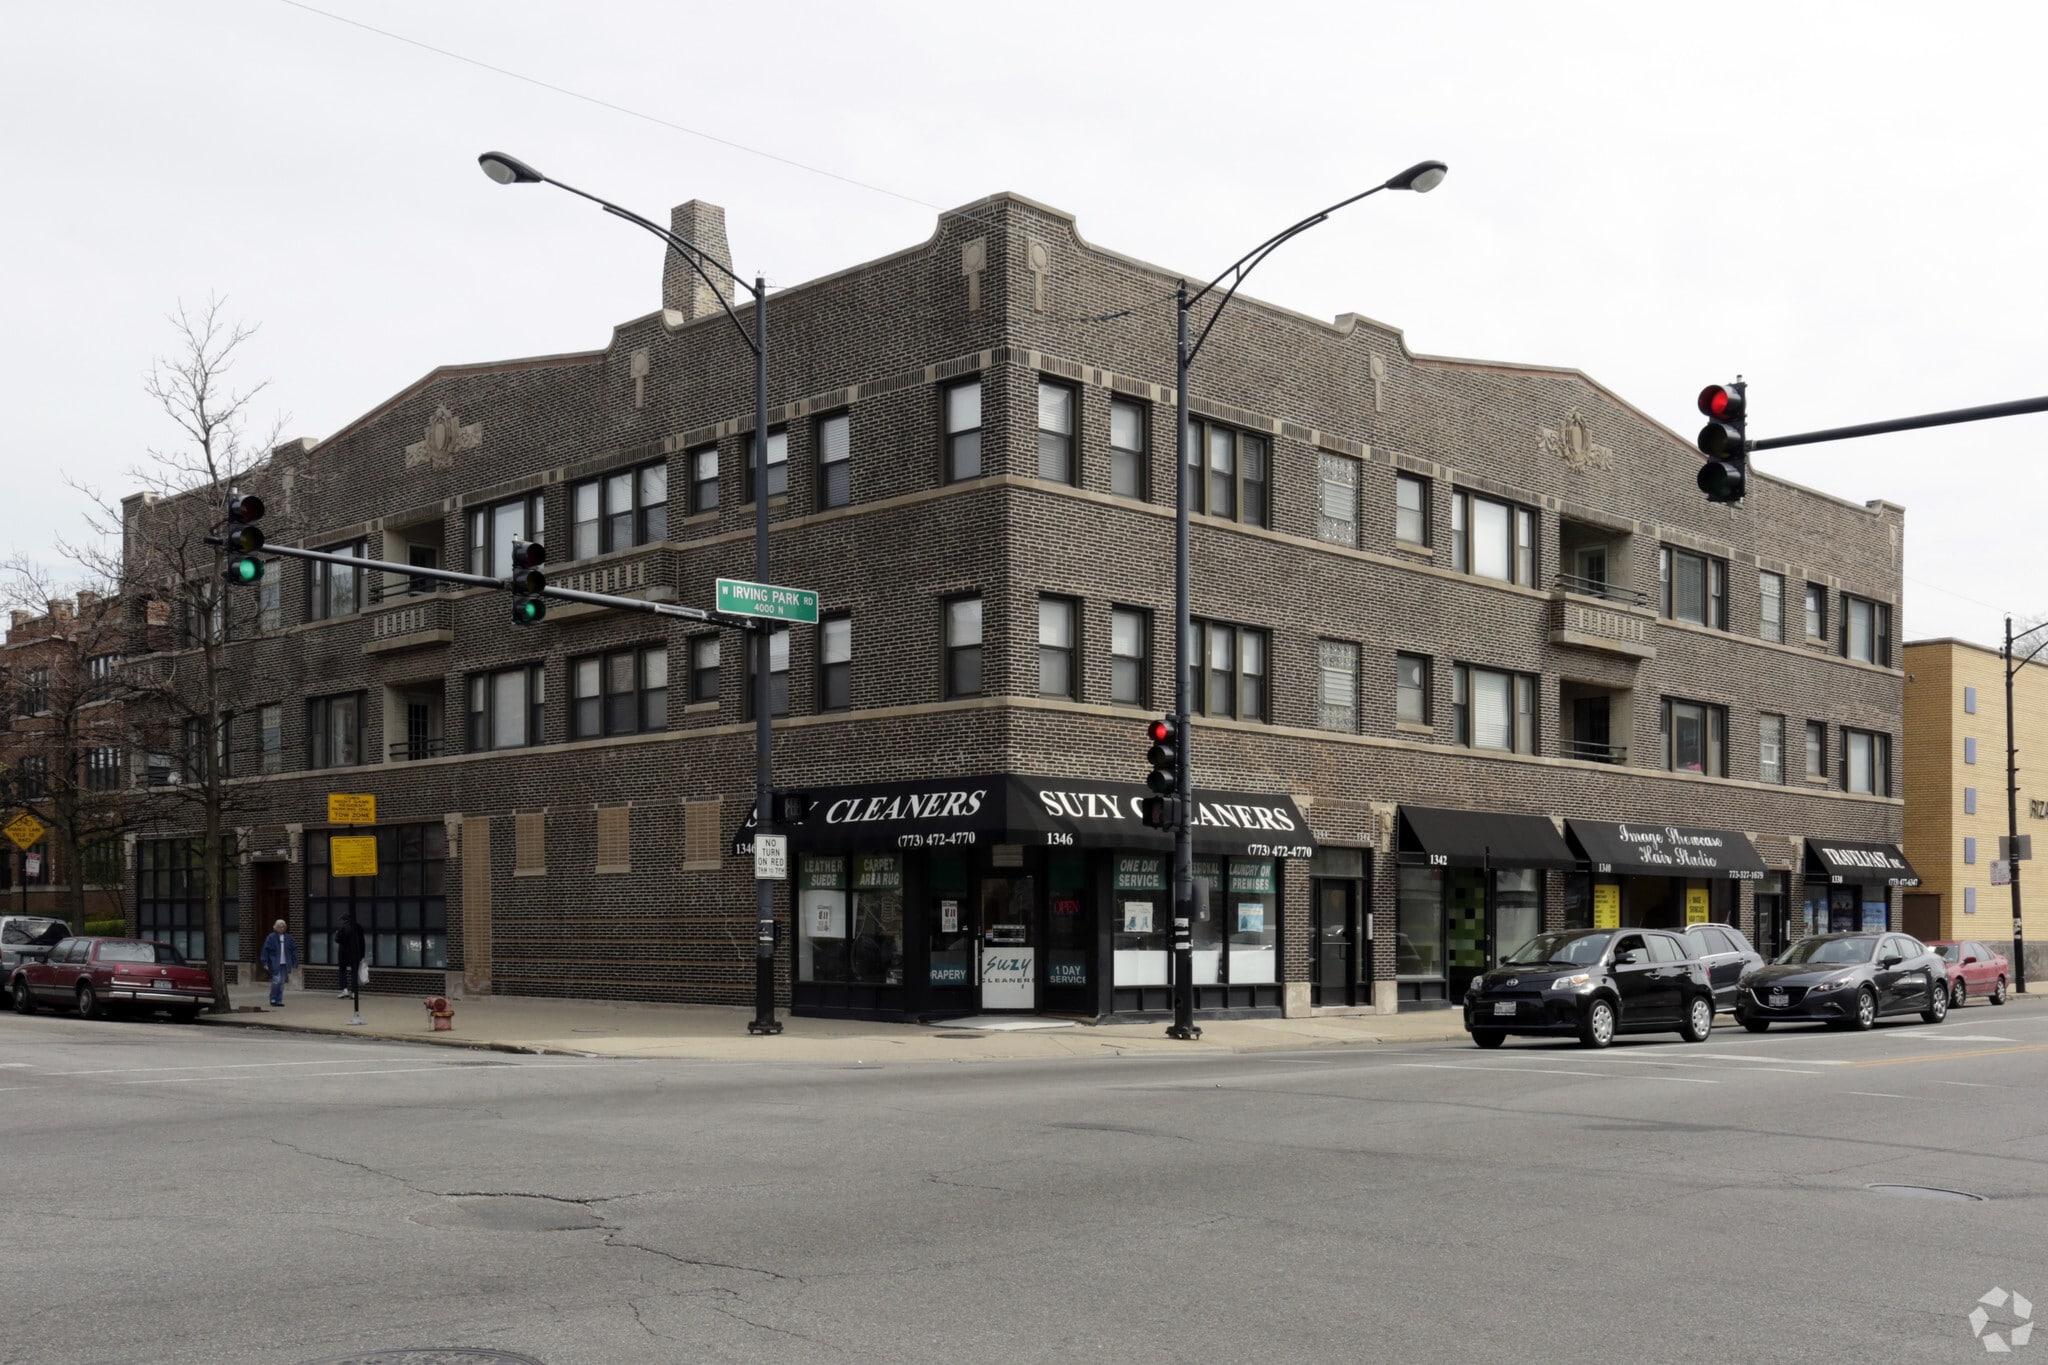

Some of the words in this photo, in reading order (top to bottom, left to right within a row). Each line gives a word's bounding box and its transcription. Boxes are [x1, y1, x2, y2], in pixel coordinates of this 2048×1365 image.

[722, 586, 729, 595] W
[733, 585, 768, 602] IRVING
[772, 591, 800, 606] PARK
[803, 597, 814, 606] RD
[754, 603, 774, 613] 4000
[778, 606, 784, 615] N
[826, 790, 987, 824] CLEANERS
[1039, 790, 1126, 820] SUZY
[1130, 796, 1295, 831] CANERS
[765, 839, 776, 847] NO
[897, 835, 924, 847] (773)
[926, 832, 976, 846] 472-4770
[1046, 833, 1073, 846] 1346
[1619, 824, 1663, 850] Image
[1665, 826, 1723, 847] Showcase
[762, 848, 780, 856] TURN
[1248, 844, 1270, 856] (773)
[1272, 846, 1312, 858] 472-4770
[1638, 845, 1672, 865] Hair
[1674, 847, 1717, 867] Studio
[758, 857, 767, 866] ON
[771, 857, 784, 866] RED
[1430, 854, 1448, 866] 1342
[1822, 848, 1891, 868] TRAVELFAST
[805, 860, 843, 872] LEATHER
[864, 859, 895, 871] CARPET
[1120, 860, 1140, 871] ONE
[1141, 860, 1159, 872] DAY
[1229, 863, 1258, 875] LAUNDRY
[1260, 865, 1271, 877] ON
[811, 874, 838, 886] SUEDE
[860, 873, 880, 886] AREA
[883, 873, 900, 886] RUG
[1119, 874, 1159, 887] SERVICE
[1729, 870, 1764, 879] 773-327-1679
[1232, 878, 1270, 890] PREMISES
[1054, 900, 1080, 914] OPEN
[930, 969, 966, 980] RAPERY
[1055, 965, 1060, 975] 1
[1062, 965, 1080, 975] DAY
[1049, 975, 1087, 984] SERVICE
